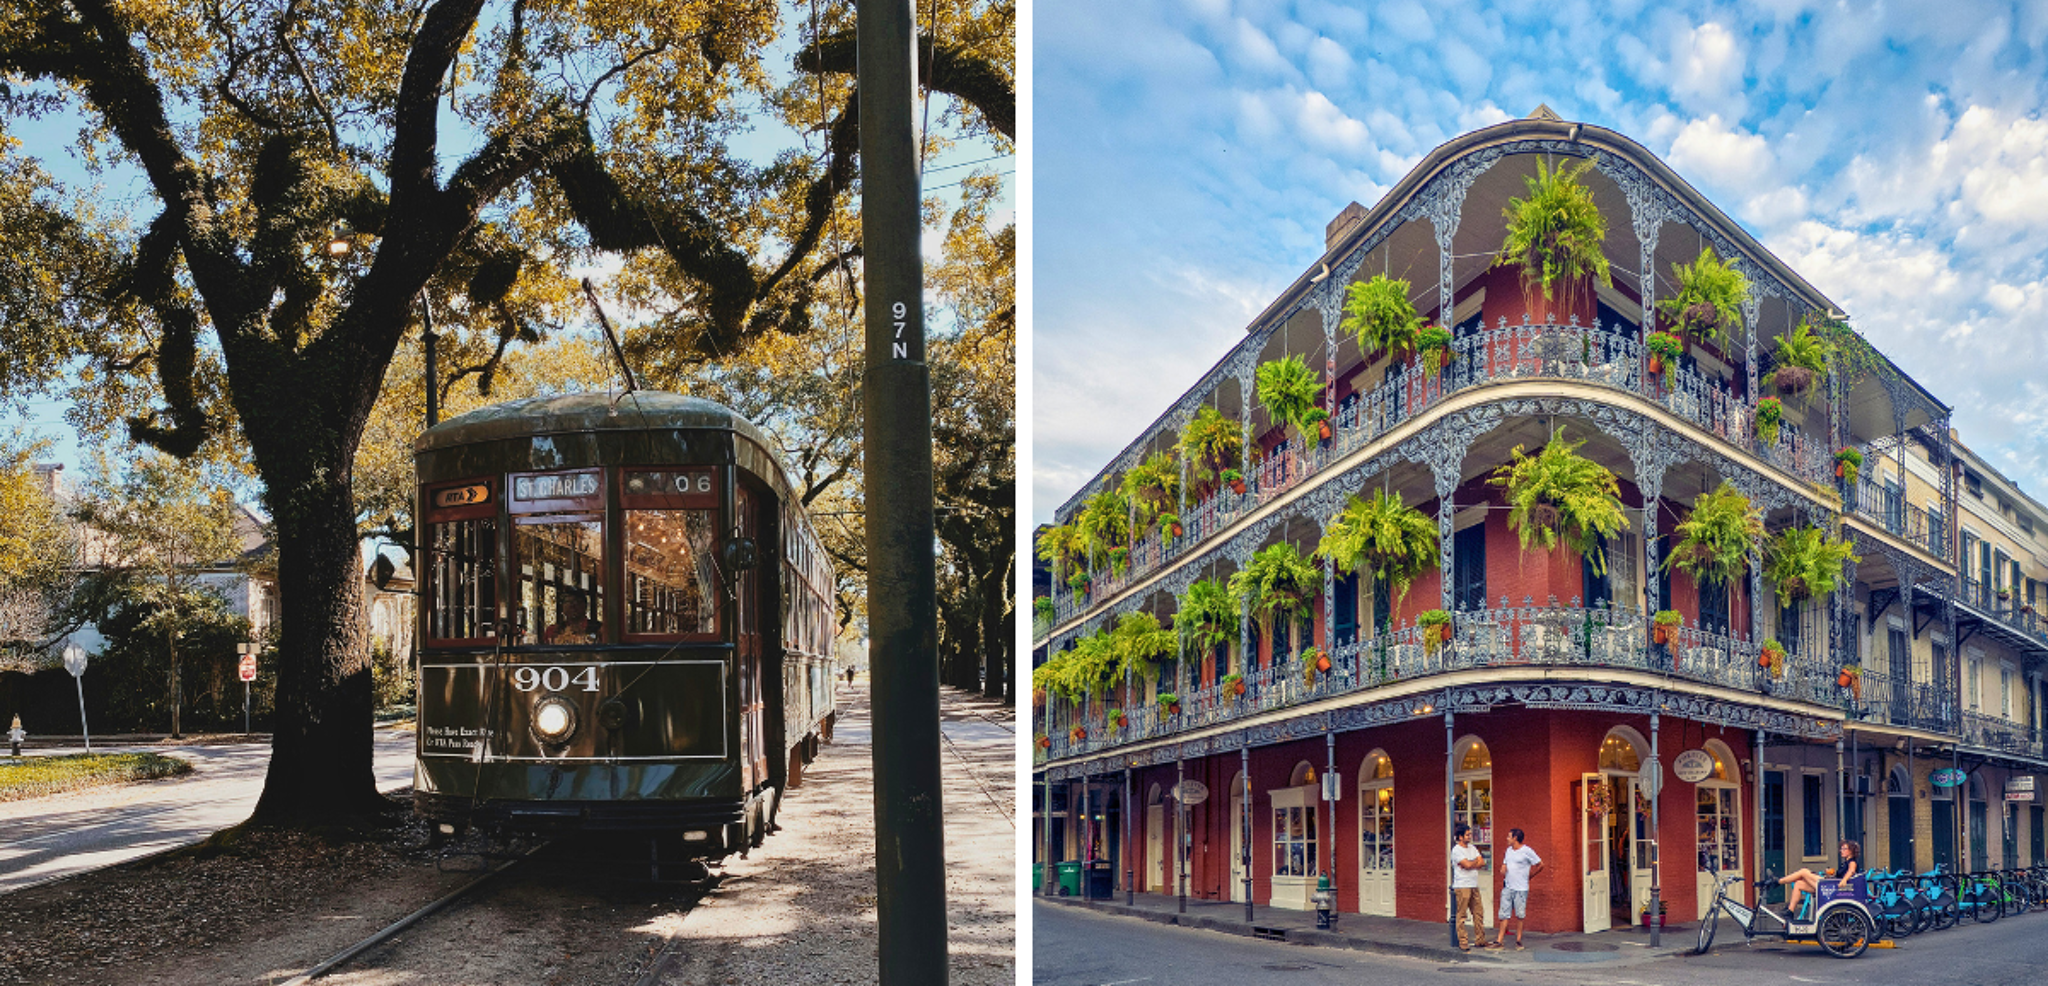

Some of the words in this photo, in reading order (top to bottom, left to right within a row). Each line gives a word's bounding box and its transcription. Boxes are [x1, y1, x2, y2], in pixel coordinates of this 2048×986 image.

[539, 478, 596, 496] CHARLES
[445, 490, 465, 503] RTA
[514, 666, 600, 692] 904
